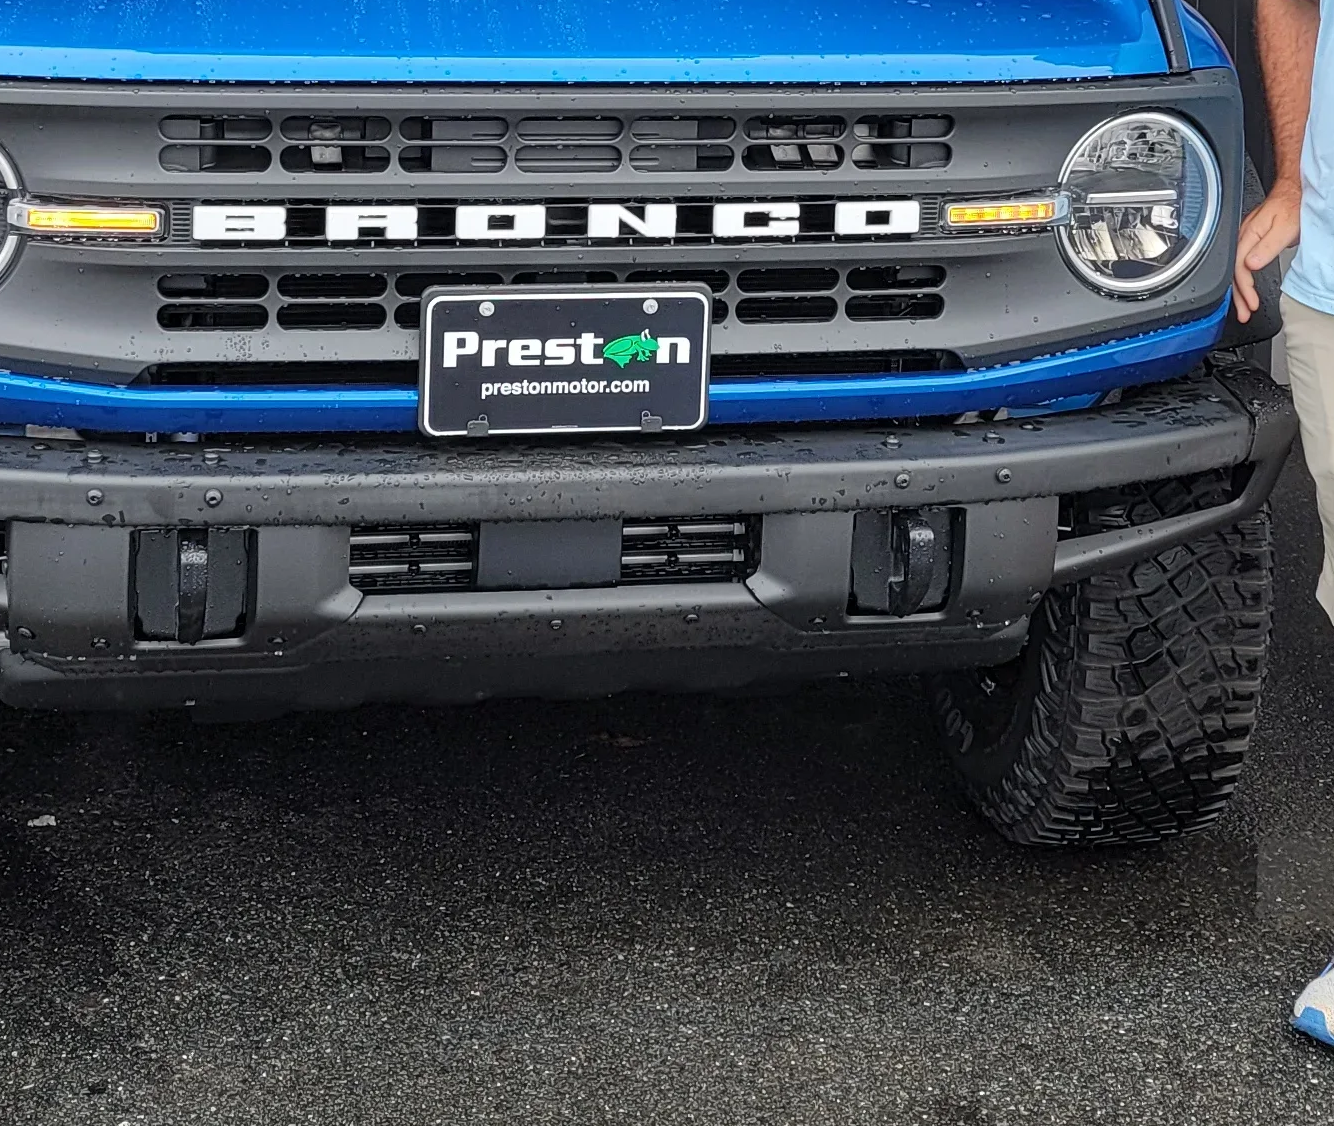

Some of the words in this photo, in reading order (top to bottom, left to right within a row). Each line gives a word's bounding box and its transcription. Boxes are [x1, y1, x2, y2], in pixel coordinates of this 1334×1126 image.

[192, 200, 921, 241] BRONCO
[442, 330, 691, 368] Prestn
[481, 378, 650, 399] prestonmotor.com
